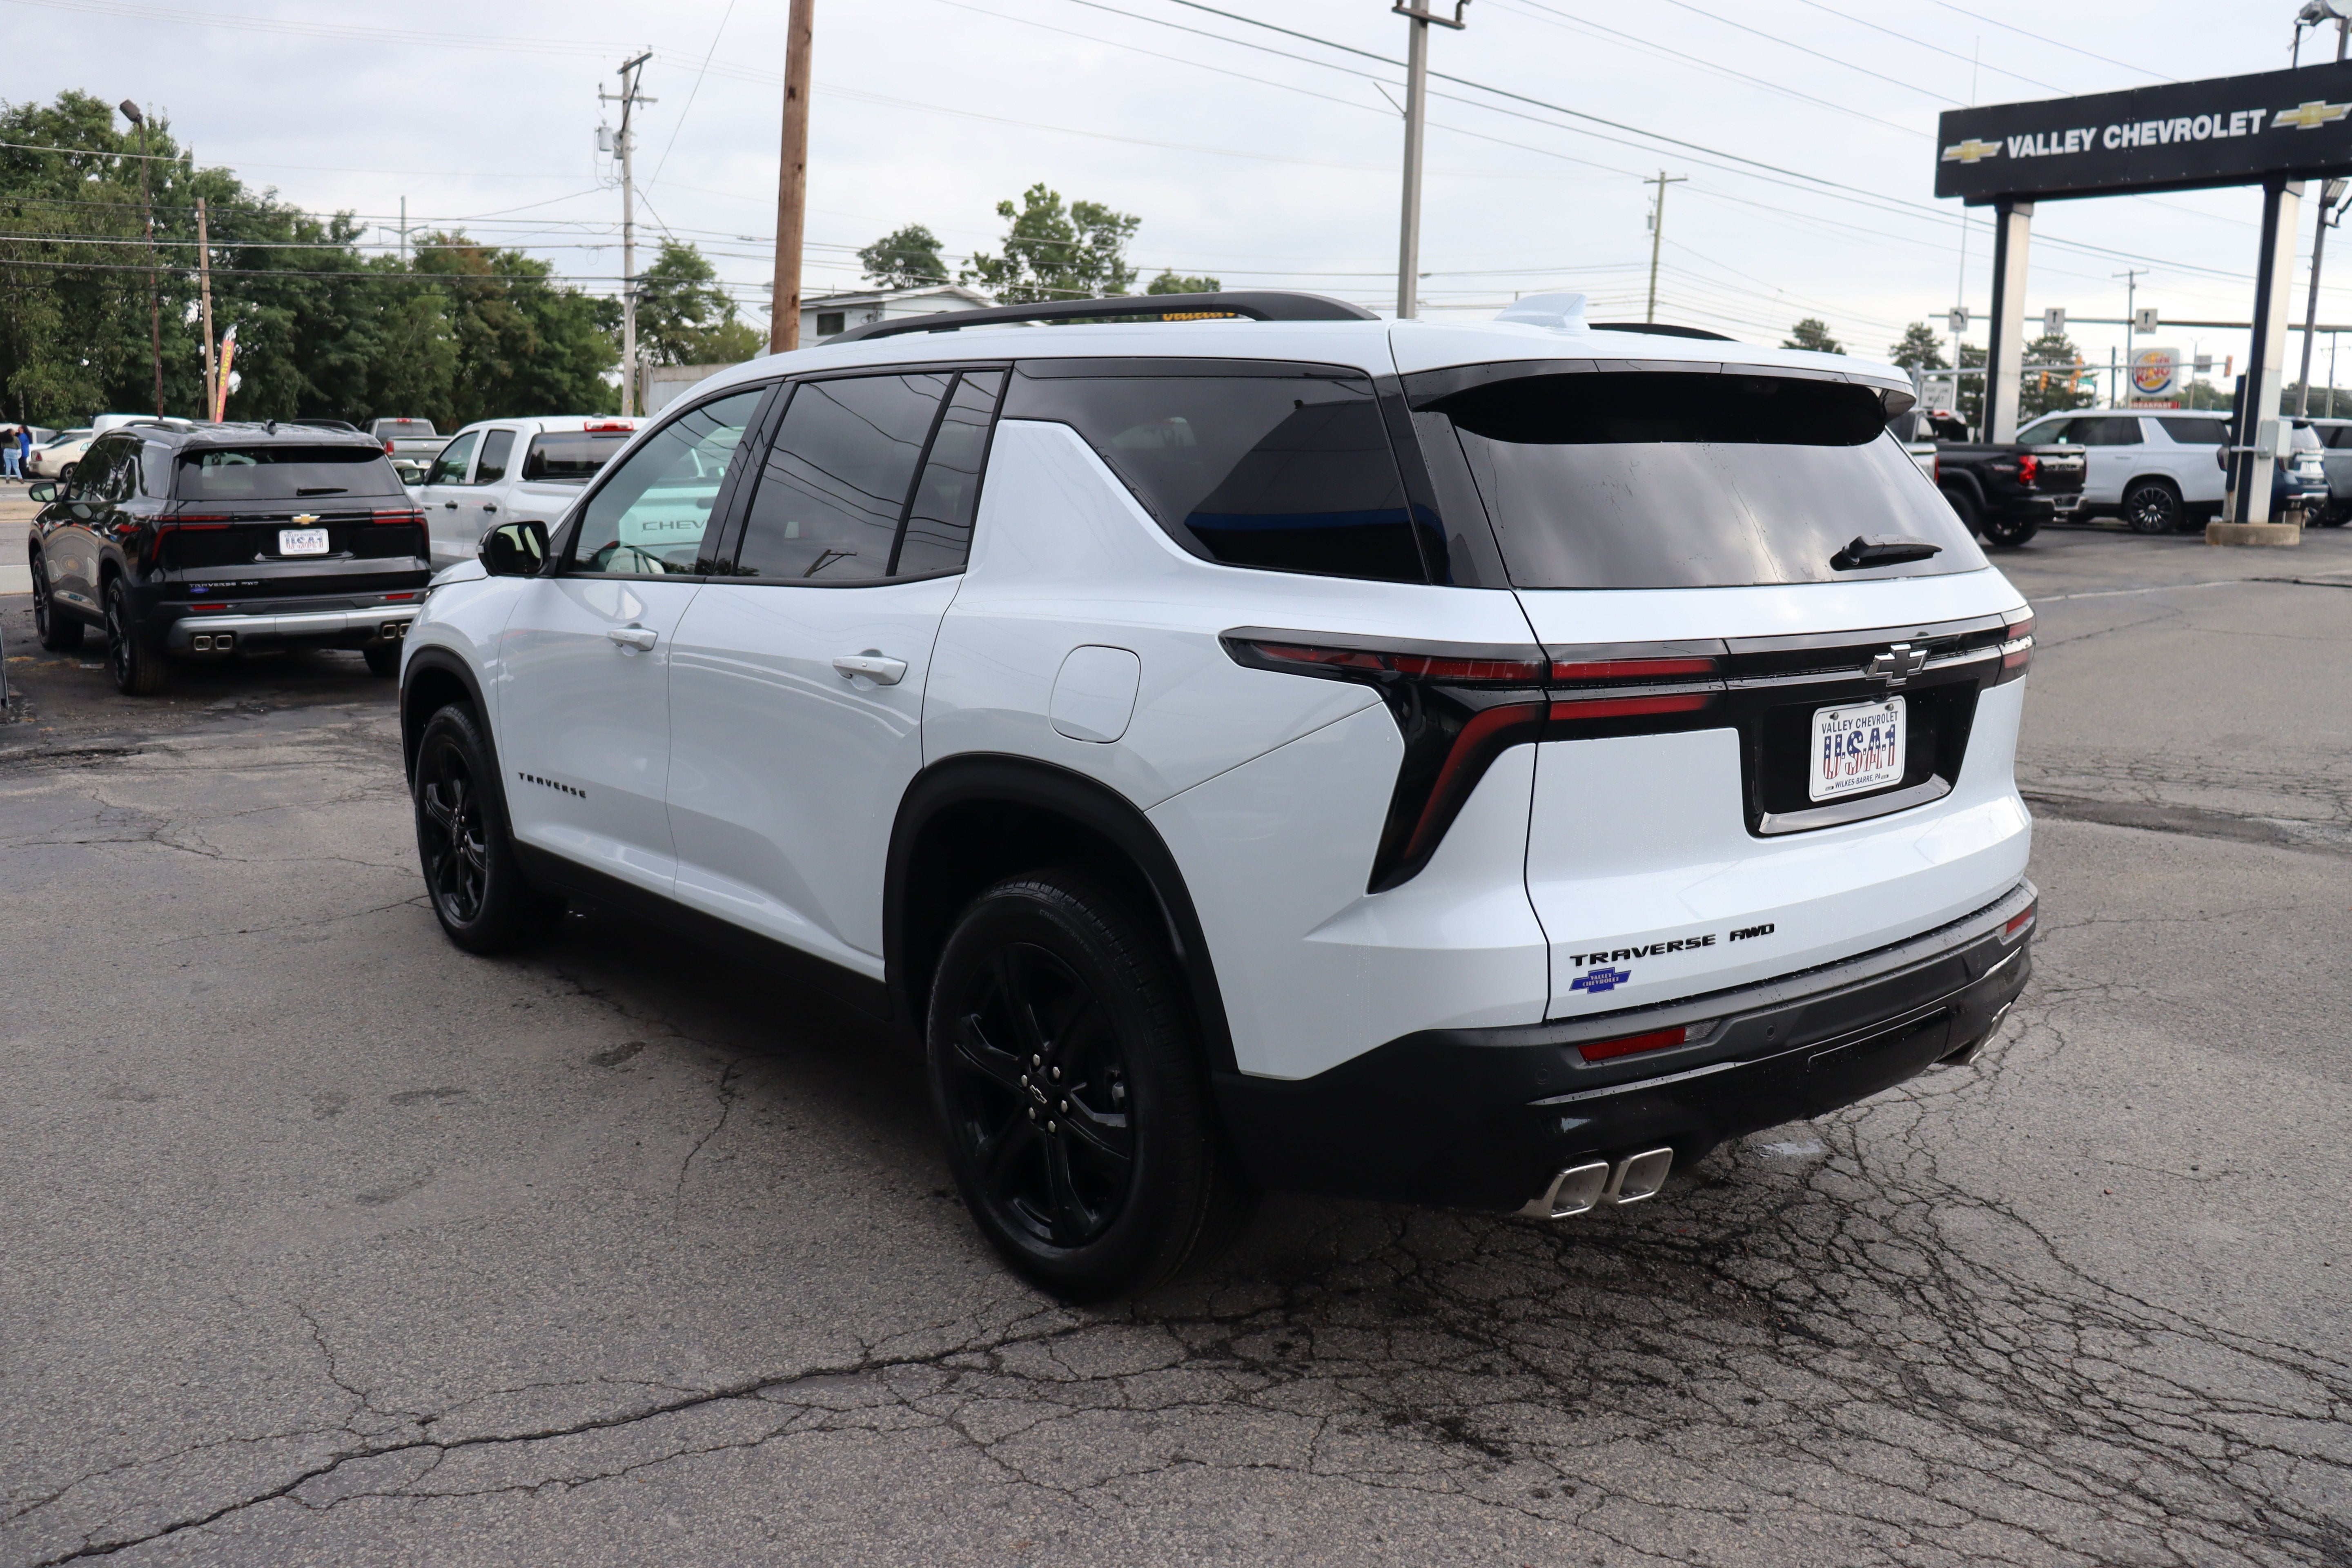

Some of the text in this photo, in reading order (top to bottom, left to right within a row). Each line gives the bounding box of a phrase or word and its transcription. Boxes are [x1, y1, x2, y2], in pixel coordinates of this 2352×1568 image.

[2007, 108, 2267, 159] VALLEY CHEVROLET
[219, 344, 232, 388] SERVICE
[1822, 711, 1898, 734] VALLEY CHEVROLET
[518, 772, 586, 798] TRAVERSE
[1835, 775, 1874, 788] WILKES-BARRE,
[1570, 923, 1775, 967] TRAVERSE AWD
[1582, 976, 1619, 987] CHEVROLET
